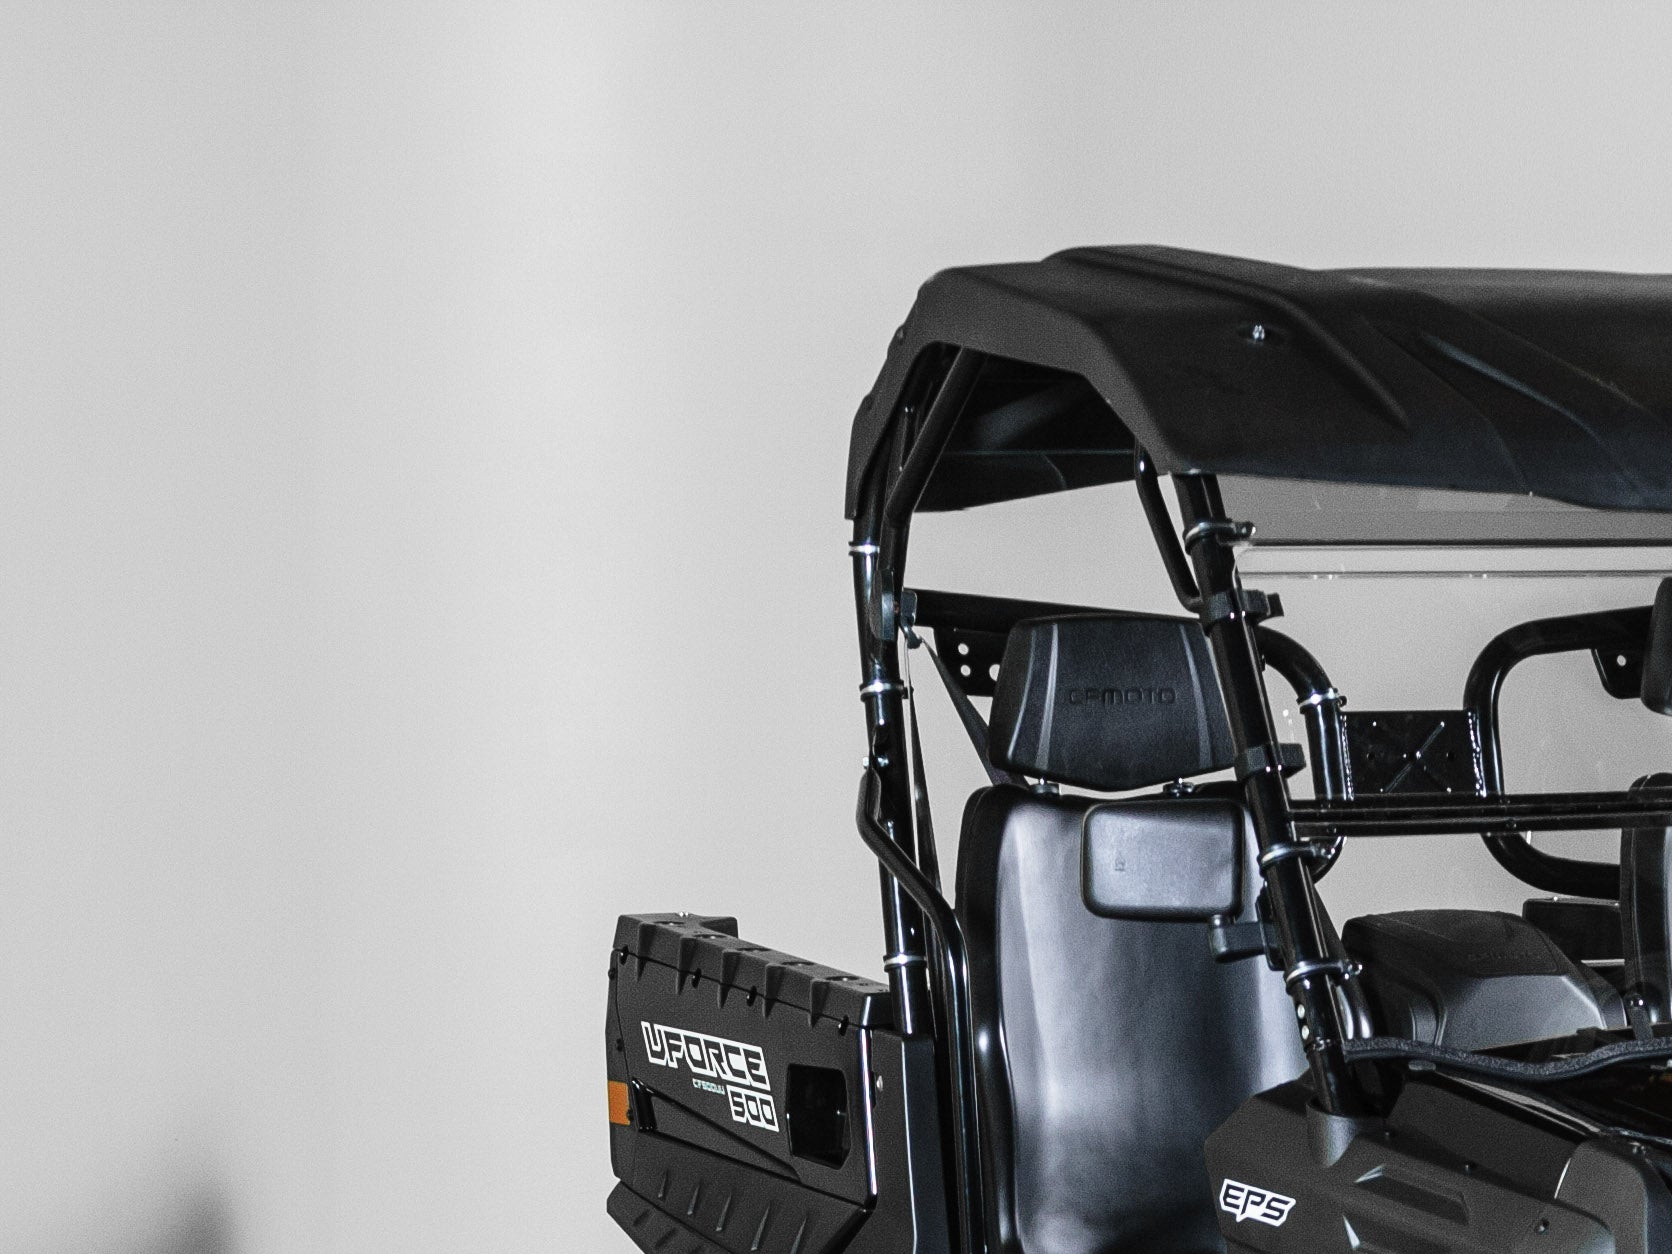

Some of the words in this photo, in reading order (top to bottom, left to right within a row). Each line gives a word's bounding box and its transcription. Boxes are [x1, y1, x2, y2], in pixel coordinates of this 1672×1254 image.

[642, 1022, 770, 1090] UFORCE
[727, 1086, 779, 1131] 500
[1221, 1180, 1294, 1224] EPS
